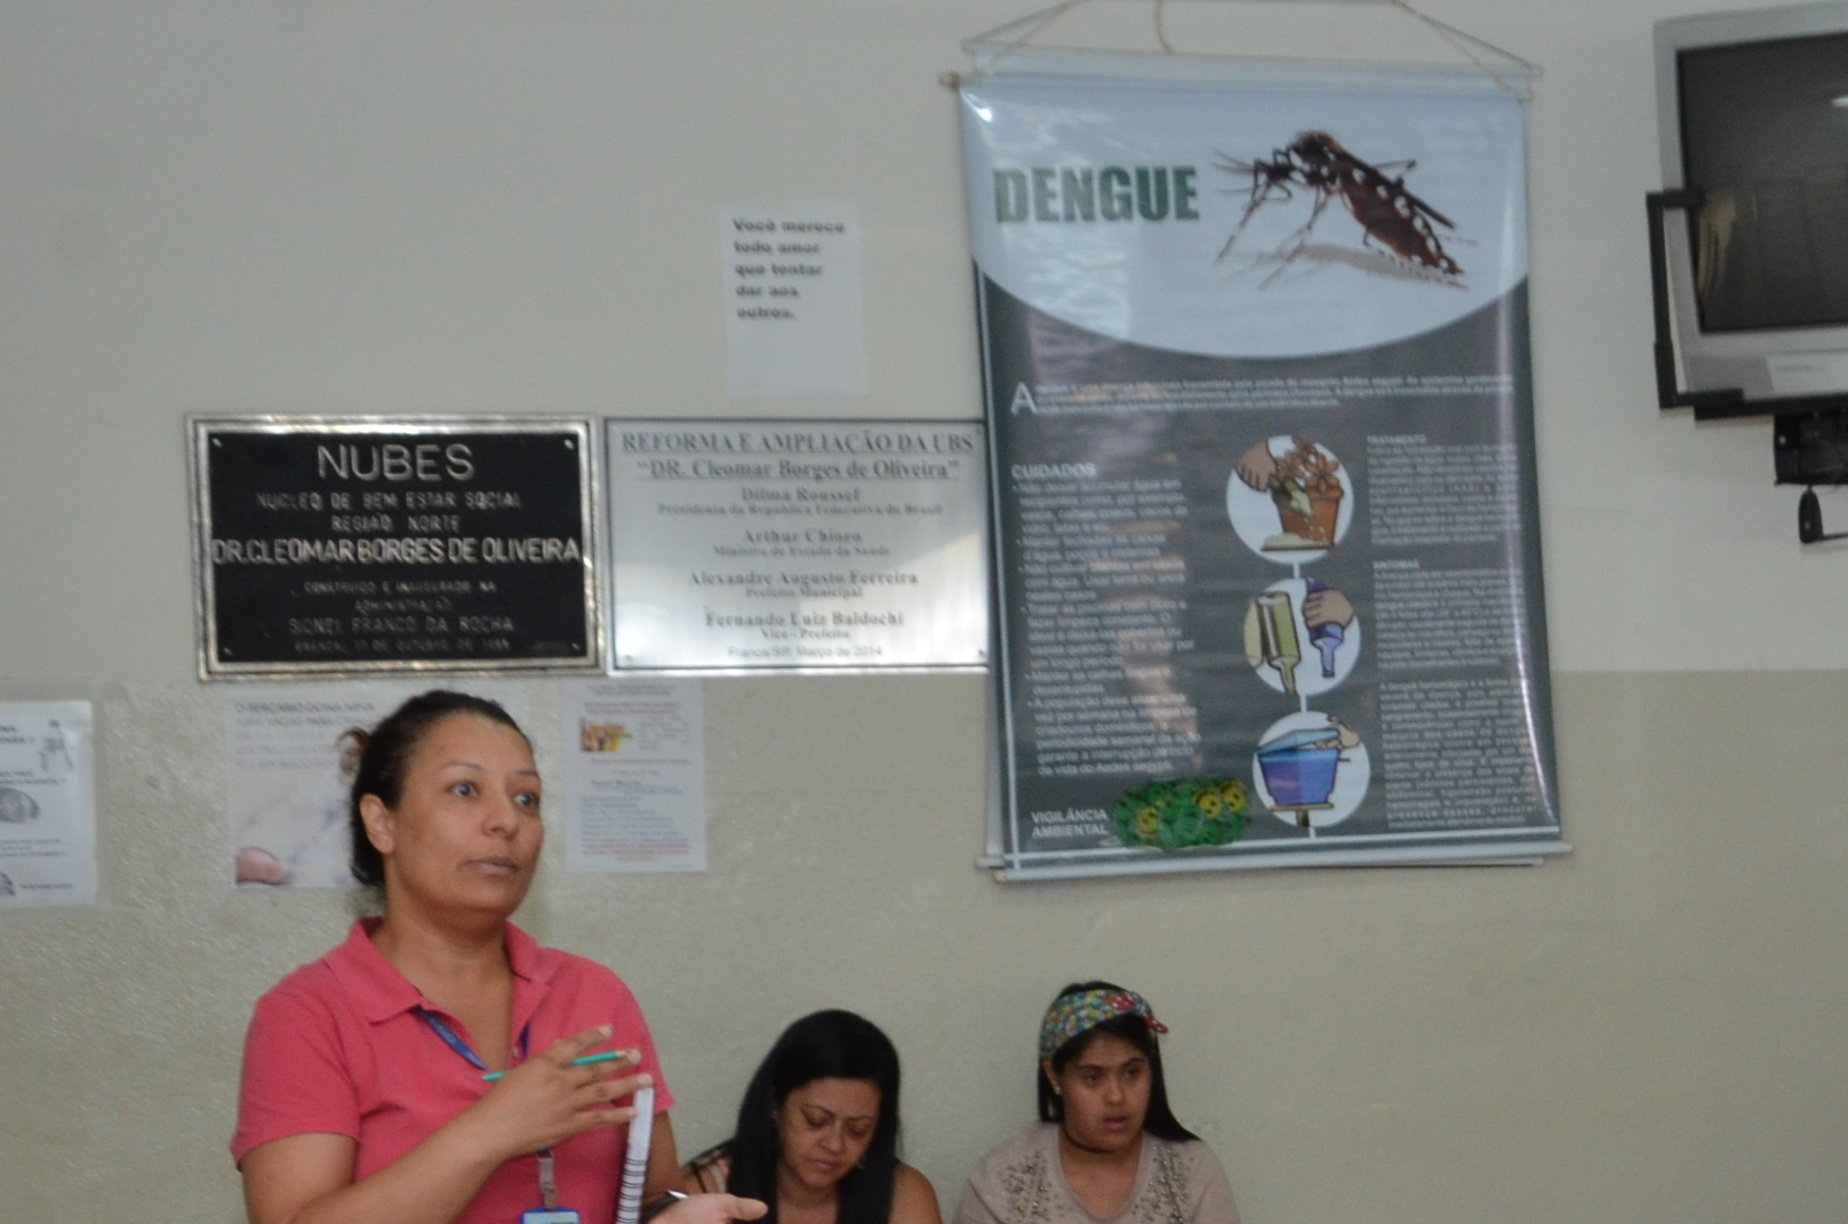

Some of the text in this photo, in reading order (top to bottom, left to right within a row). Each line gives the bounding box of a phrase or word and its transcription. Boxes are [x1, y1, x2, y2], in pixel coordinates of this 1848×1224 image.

[993, 166, 1199, 223] DENGUE
[733, 218, 845, 233] Você merece
[734, 241, 820, 253] todo amor
[735, 263, 823, 277] que tentar
[735, 284, 799, 296] dar aos
[622, 429, 974, 453] REFORMA E AMPLIAÇÃO DA UBS
[318, 443, 475, 482] NUBES
[693, 459, 772, 477] Cleomar
[778, 459, 841, 481] Borges
[847, 460, 867, 477] de
[1011, 463, 1097, 480] CUIDADOS
[331, 492, 350, 510] DE
[363, 491, 398, 510] BEM
[405, 491, 456, 509] ESTAR
[464, 491, 521, 510] SOCIAL
[742, 487, 790, 501] Dilma
[408, 515, 461, 533] NORTE
[357, 538, 446, 564] BORGES
[449, 538, 479, 563] DE
[482, 537, 580, 563] OLIVEIRA
[687, 571, 918, 588] Alexandre Augusto Ferreira
[705, 611, 904, 627] Fernando Luiz Baldochi
[1031, 808, 1108, 824] VIGILÂNCIA
[1031, 824, 1108, 838] AMBIENTAL
